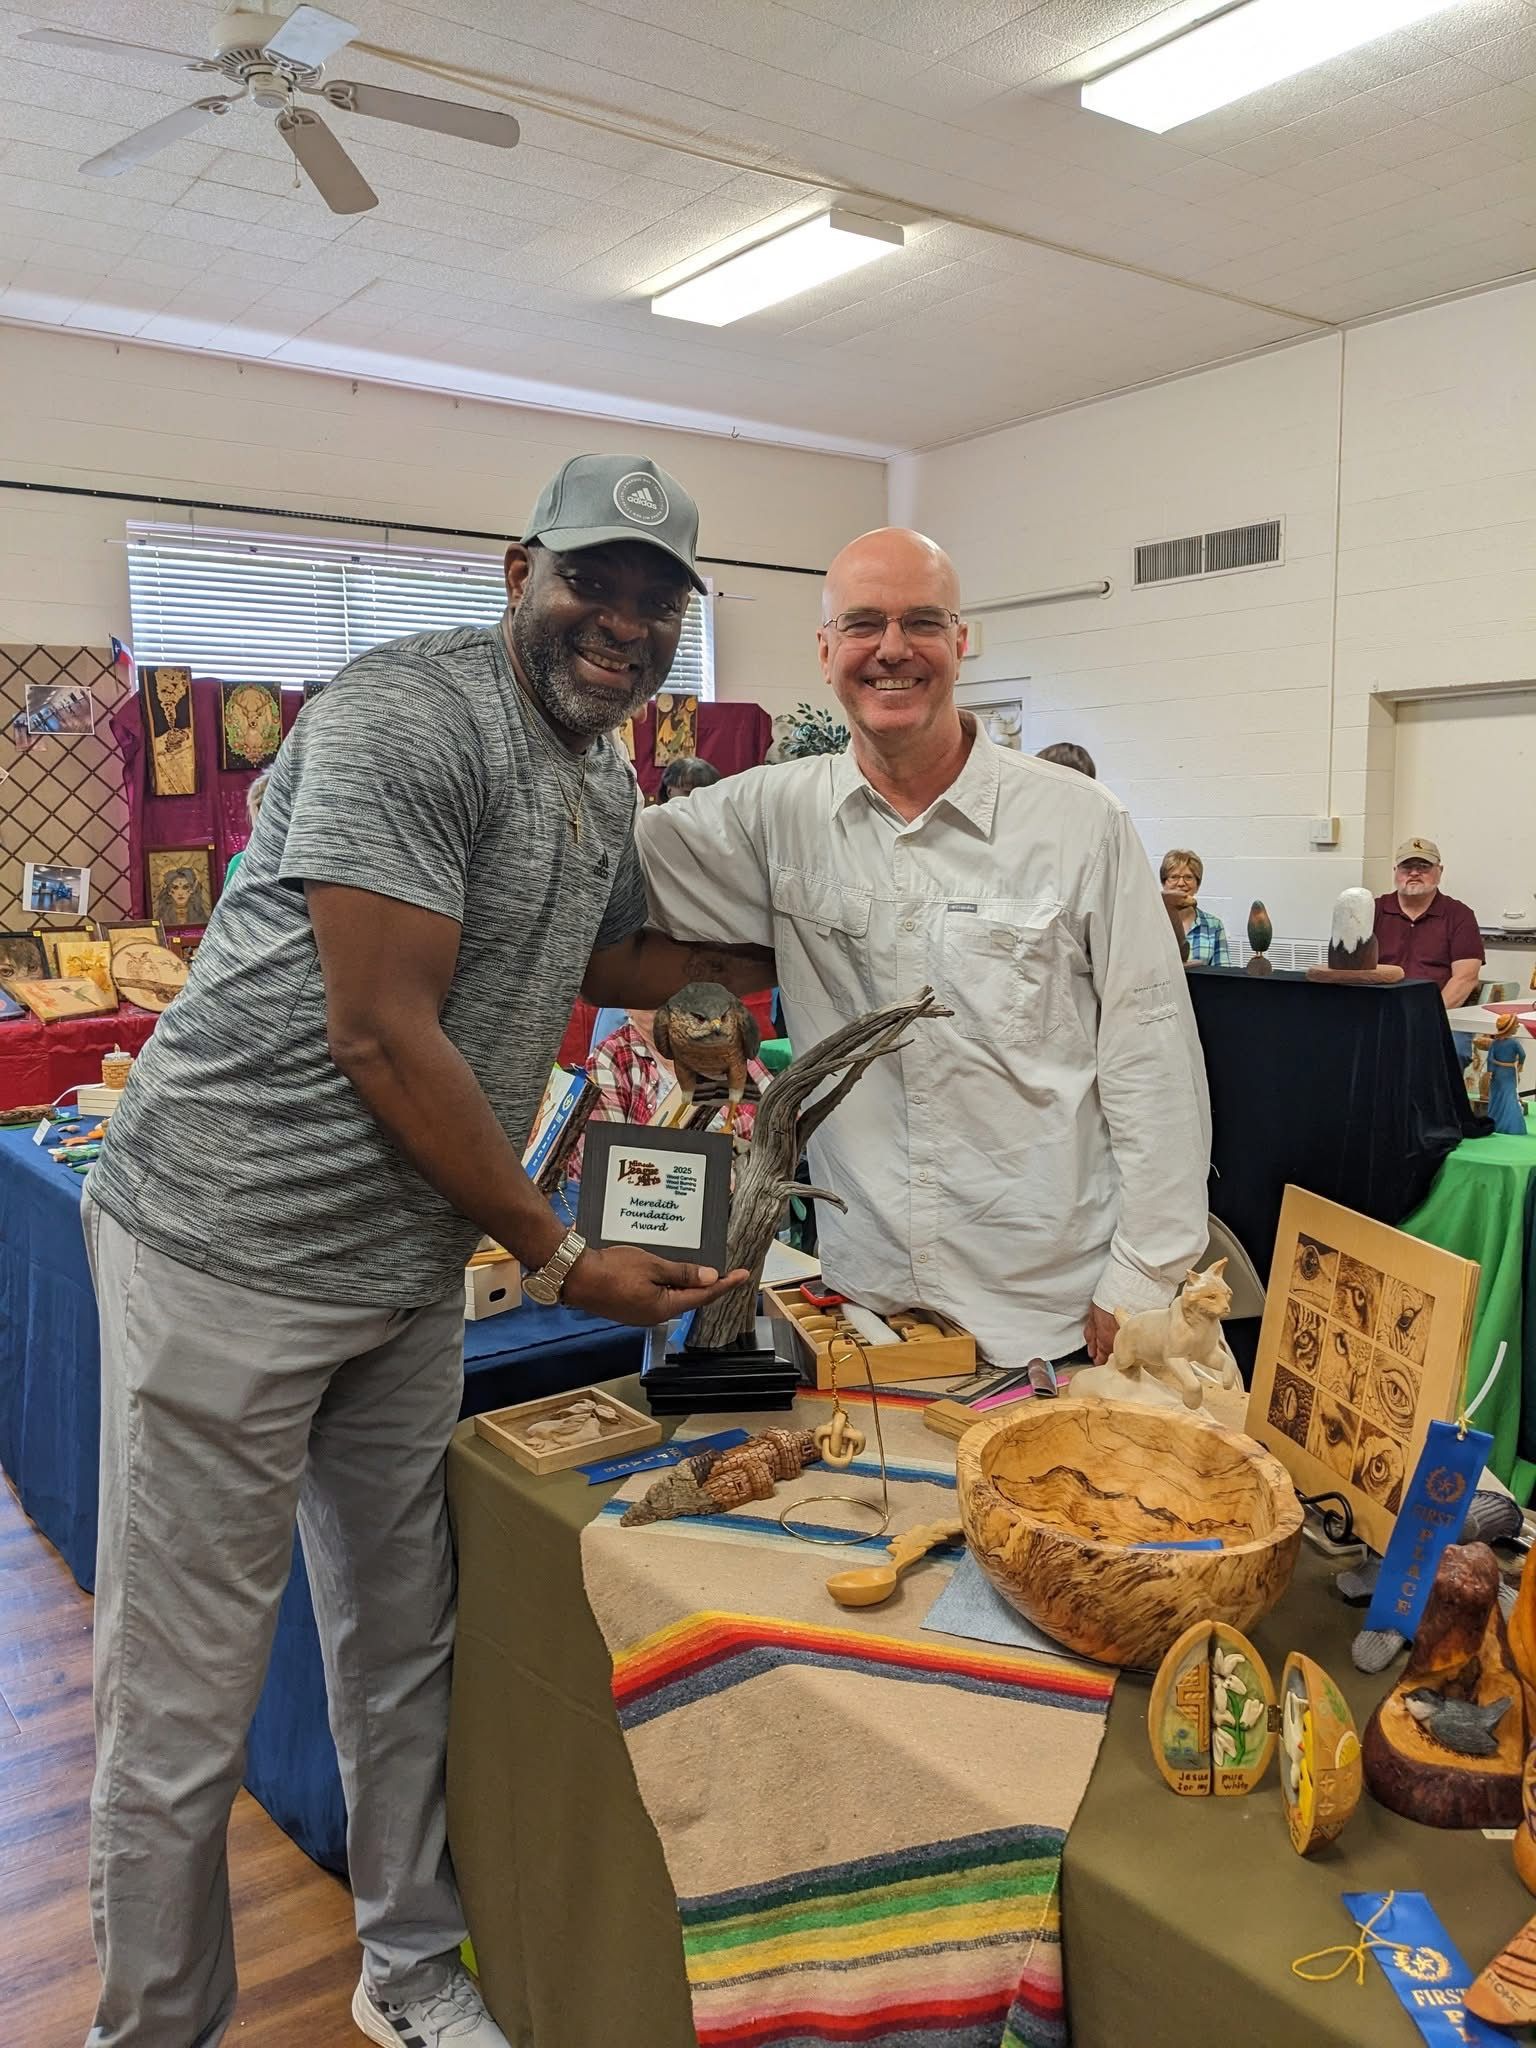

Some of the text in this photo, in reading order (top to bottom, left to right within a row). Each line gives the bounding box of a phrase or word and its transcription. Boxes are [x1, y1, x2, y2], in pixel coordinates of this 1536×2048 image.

[627, 496, 657, 510] adidas
[673, 1166, 692, 1174] 2025
[634, 1174, 661, 1187] Arts
[630, 1197, 679, 1210] Meredith
[620, 1208, 685, 1222] Foundation
[631, 1221, 669, 1232] Award
[1486, 1973, 1521, 2013] HOME
